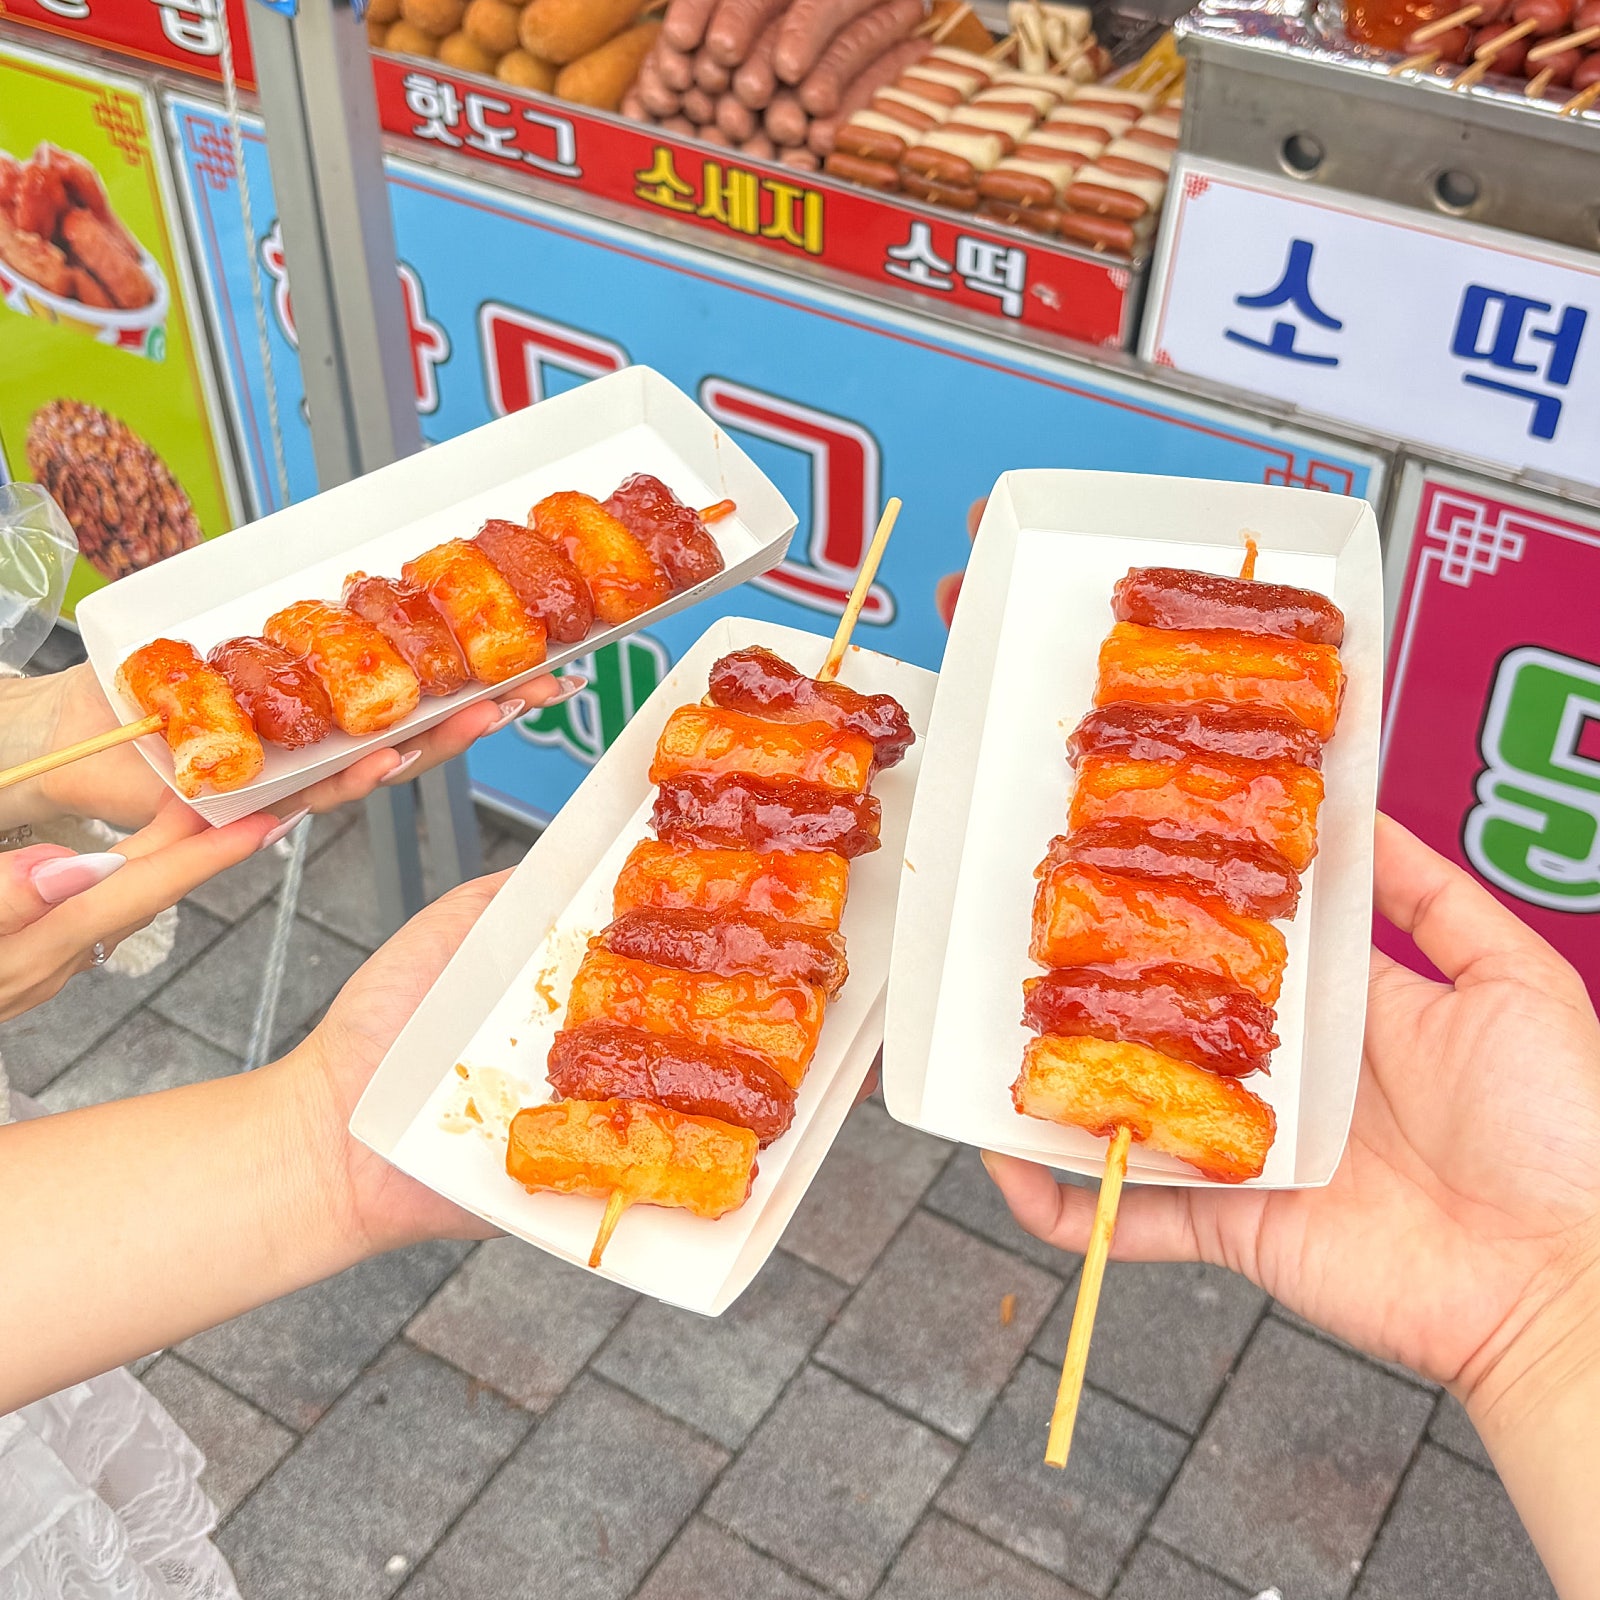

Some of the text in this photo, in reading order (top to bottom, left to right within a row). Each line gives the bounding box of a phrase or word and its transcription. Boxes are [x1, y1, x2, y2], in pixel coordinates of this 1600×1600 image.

[403, 73, 1027, 318] 핫도그 소세지 소떡
